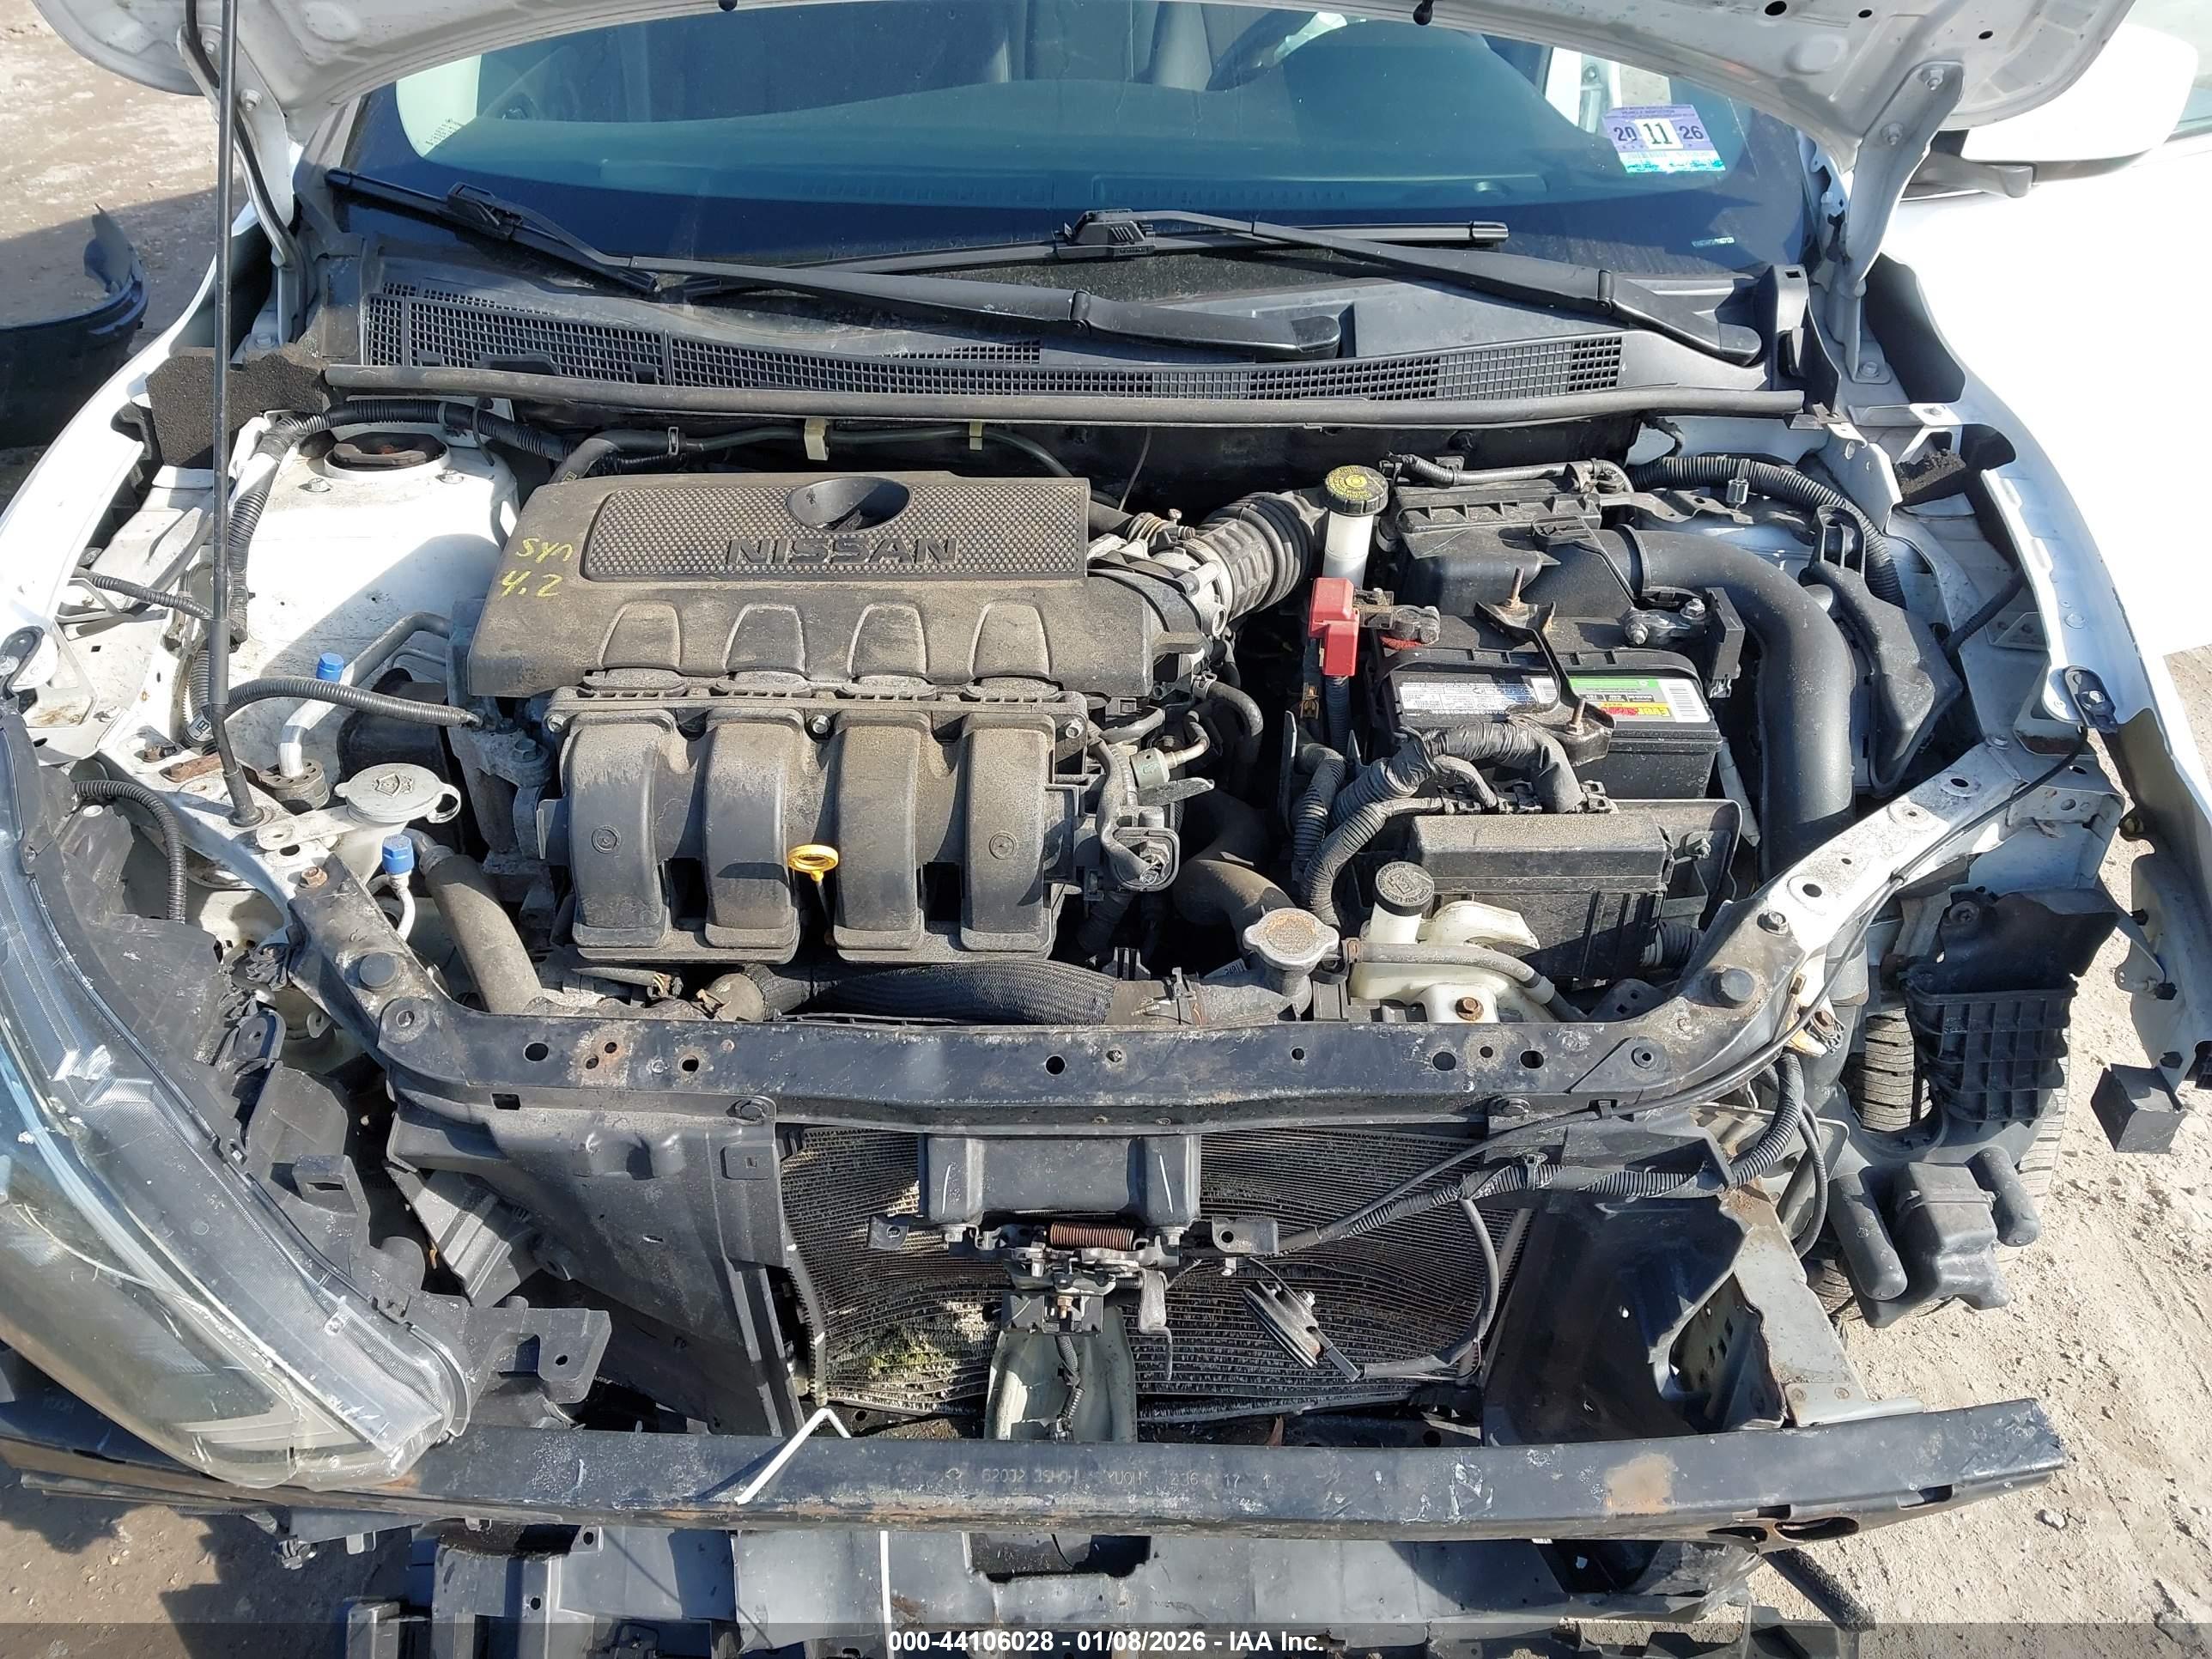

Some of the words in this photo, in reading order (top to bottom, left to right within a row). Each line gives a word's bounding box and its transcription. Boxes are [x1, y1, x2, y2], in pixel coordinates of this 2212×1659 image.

[1613, 126, 1638, 142] 20
[1643, 122, 1674, 145] 11
[1679, 125, 1705, 140] 26
[726, 537, 959, 565] NISSAN
[498, 570, 563, 601] 4.2
